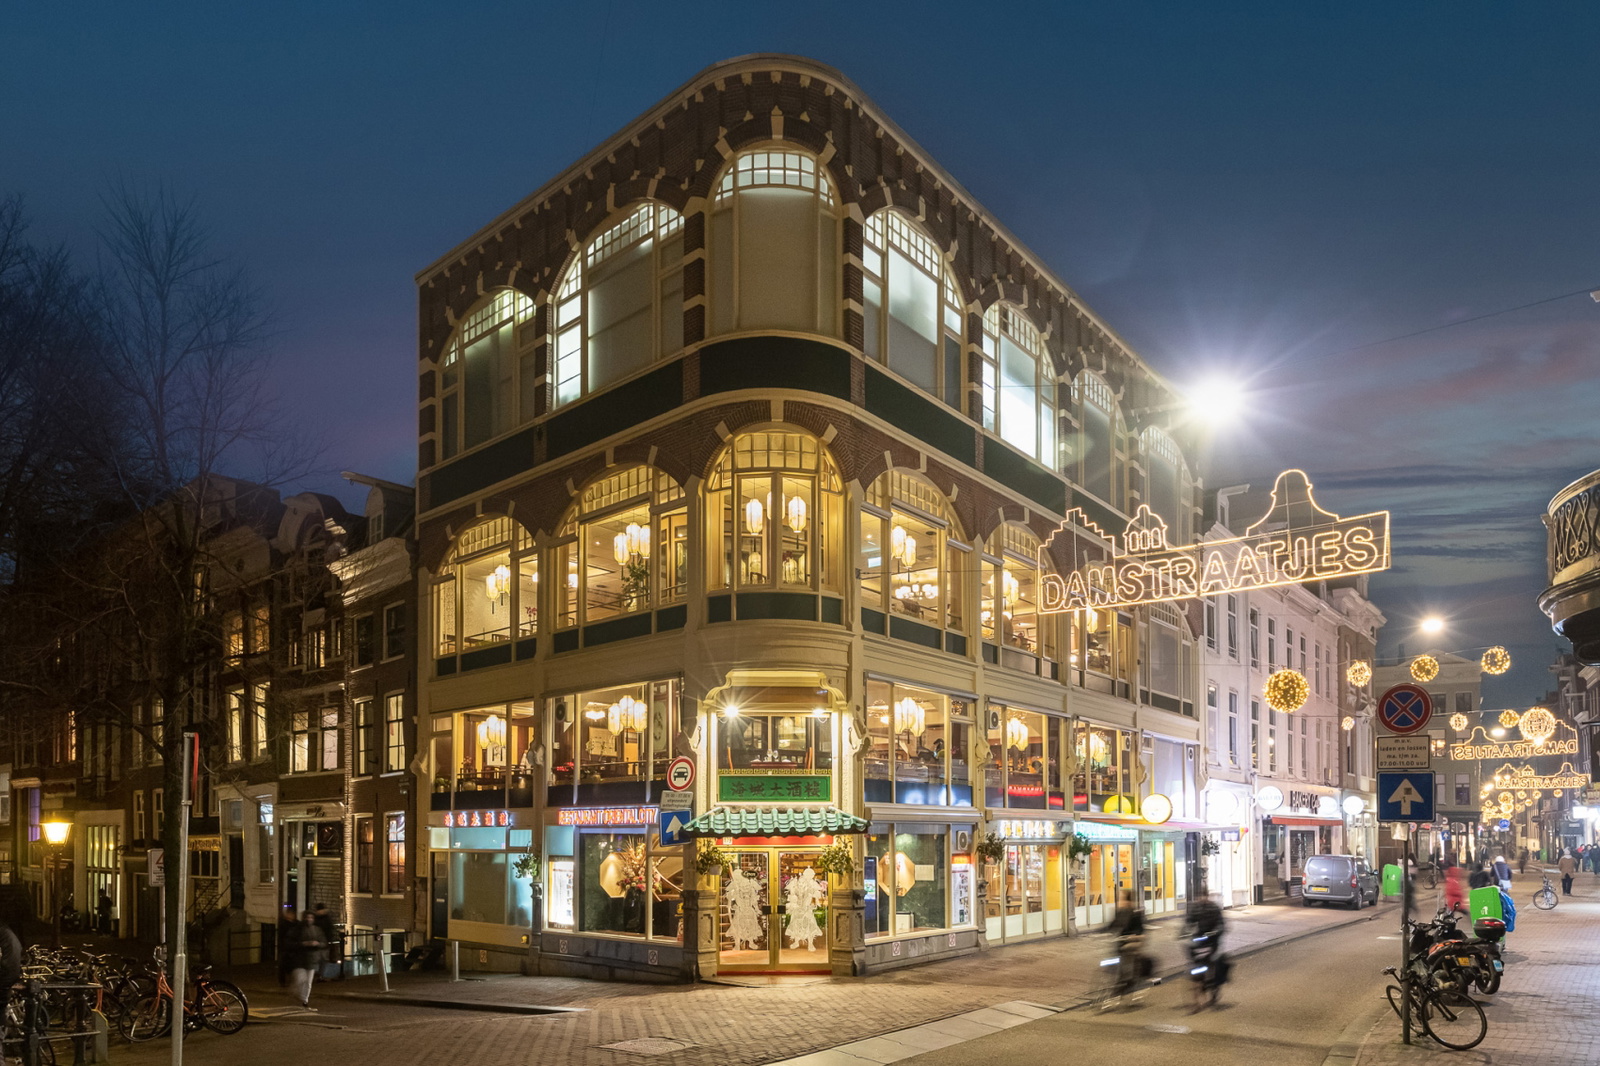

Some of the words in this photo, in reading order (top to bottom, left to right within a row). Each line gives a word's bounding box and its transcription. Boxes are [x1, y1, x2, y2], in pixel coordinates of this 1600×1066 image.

[1041, 526, 1379, 611] DAMSTRAATJES
[1496, 777, 1587, 788] DAMSTRAATJES
[558, 809, 604, 825] RESTAURANT
[604, 808, 639, 824] ORIENTAL
[639, 807, 658, 824] CITY
